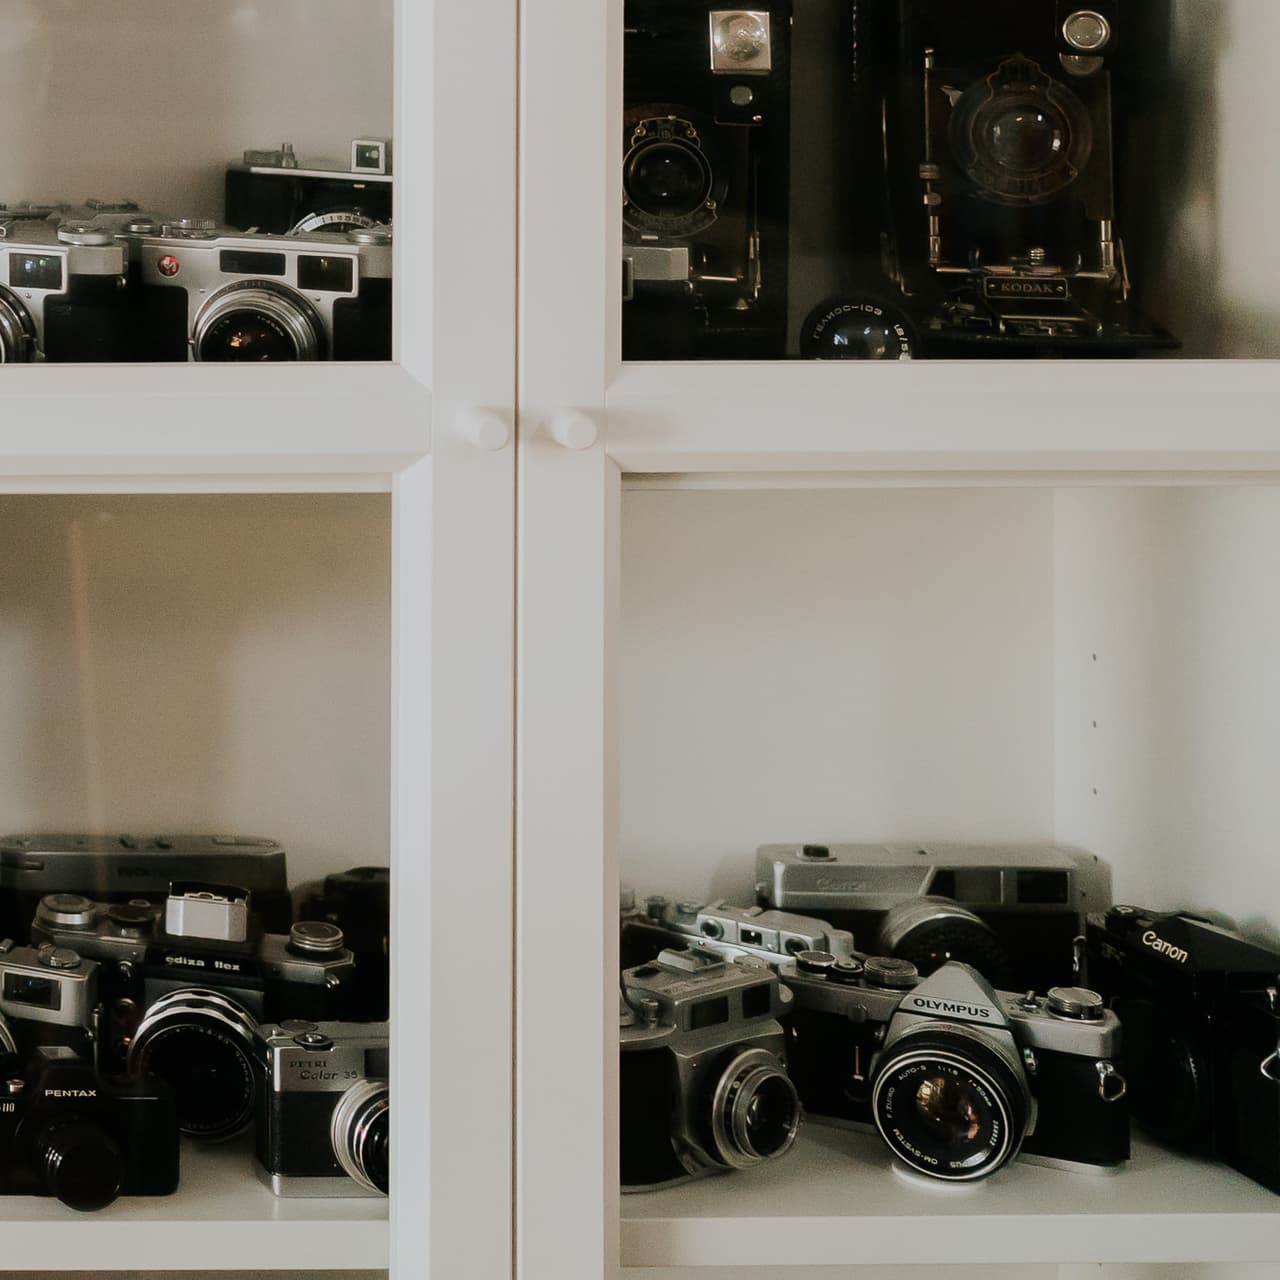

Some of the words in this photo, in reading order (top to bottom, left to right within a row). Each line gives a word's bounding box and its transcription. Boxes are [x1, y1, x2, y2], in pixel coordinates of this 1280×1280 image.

[1000, 282, 1054, 294] KODAK
[1142, 930, 1189, 964] Canon
[163, 955, 206, 968] edixa
[912, 997, 990, 1019] OLYMPUS
[299, 1069, 339, 1081] Color
[44, 1088, 98, 1098] PENTAX
